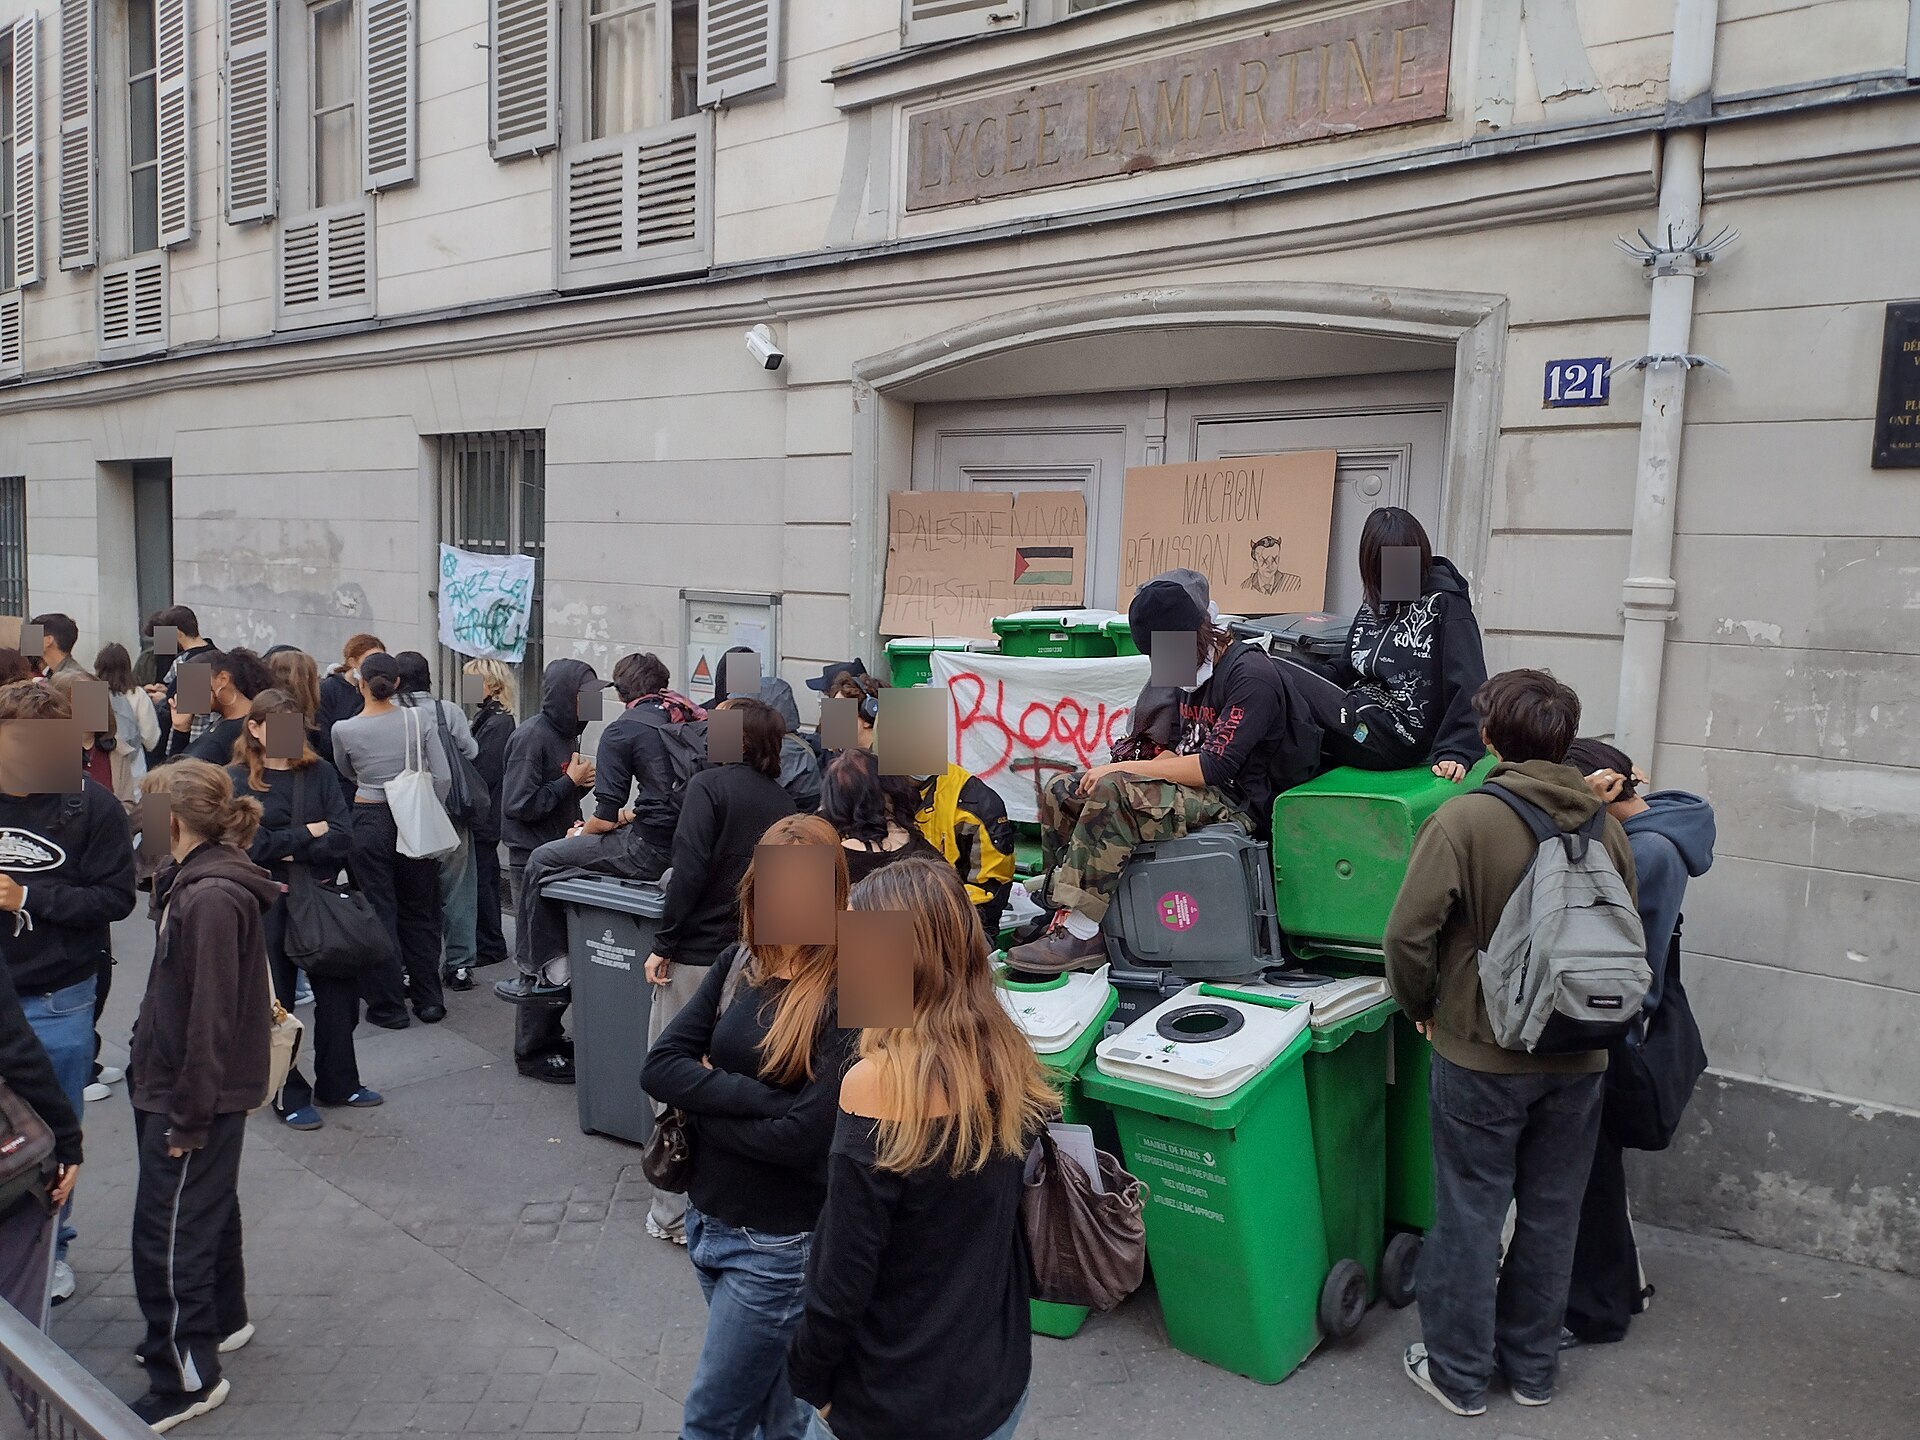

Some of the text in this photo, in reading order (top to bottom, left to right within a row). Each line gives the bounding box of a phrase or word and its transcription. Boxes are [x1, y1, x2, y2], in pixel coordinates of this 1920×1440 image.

[918, 23, 1431, 191] LYCÉE LAMARTINE
[1548, 363, 1604, 401] 121
[1182, 468, 1264, 525] MACRON
[1125, 531, 1230, 588] DÉMISSION
[1143, 1138, 1201, 1161] MAIRIE DE PARIS
